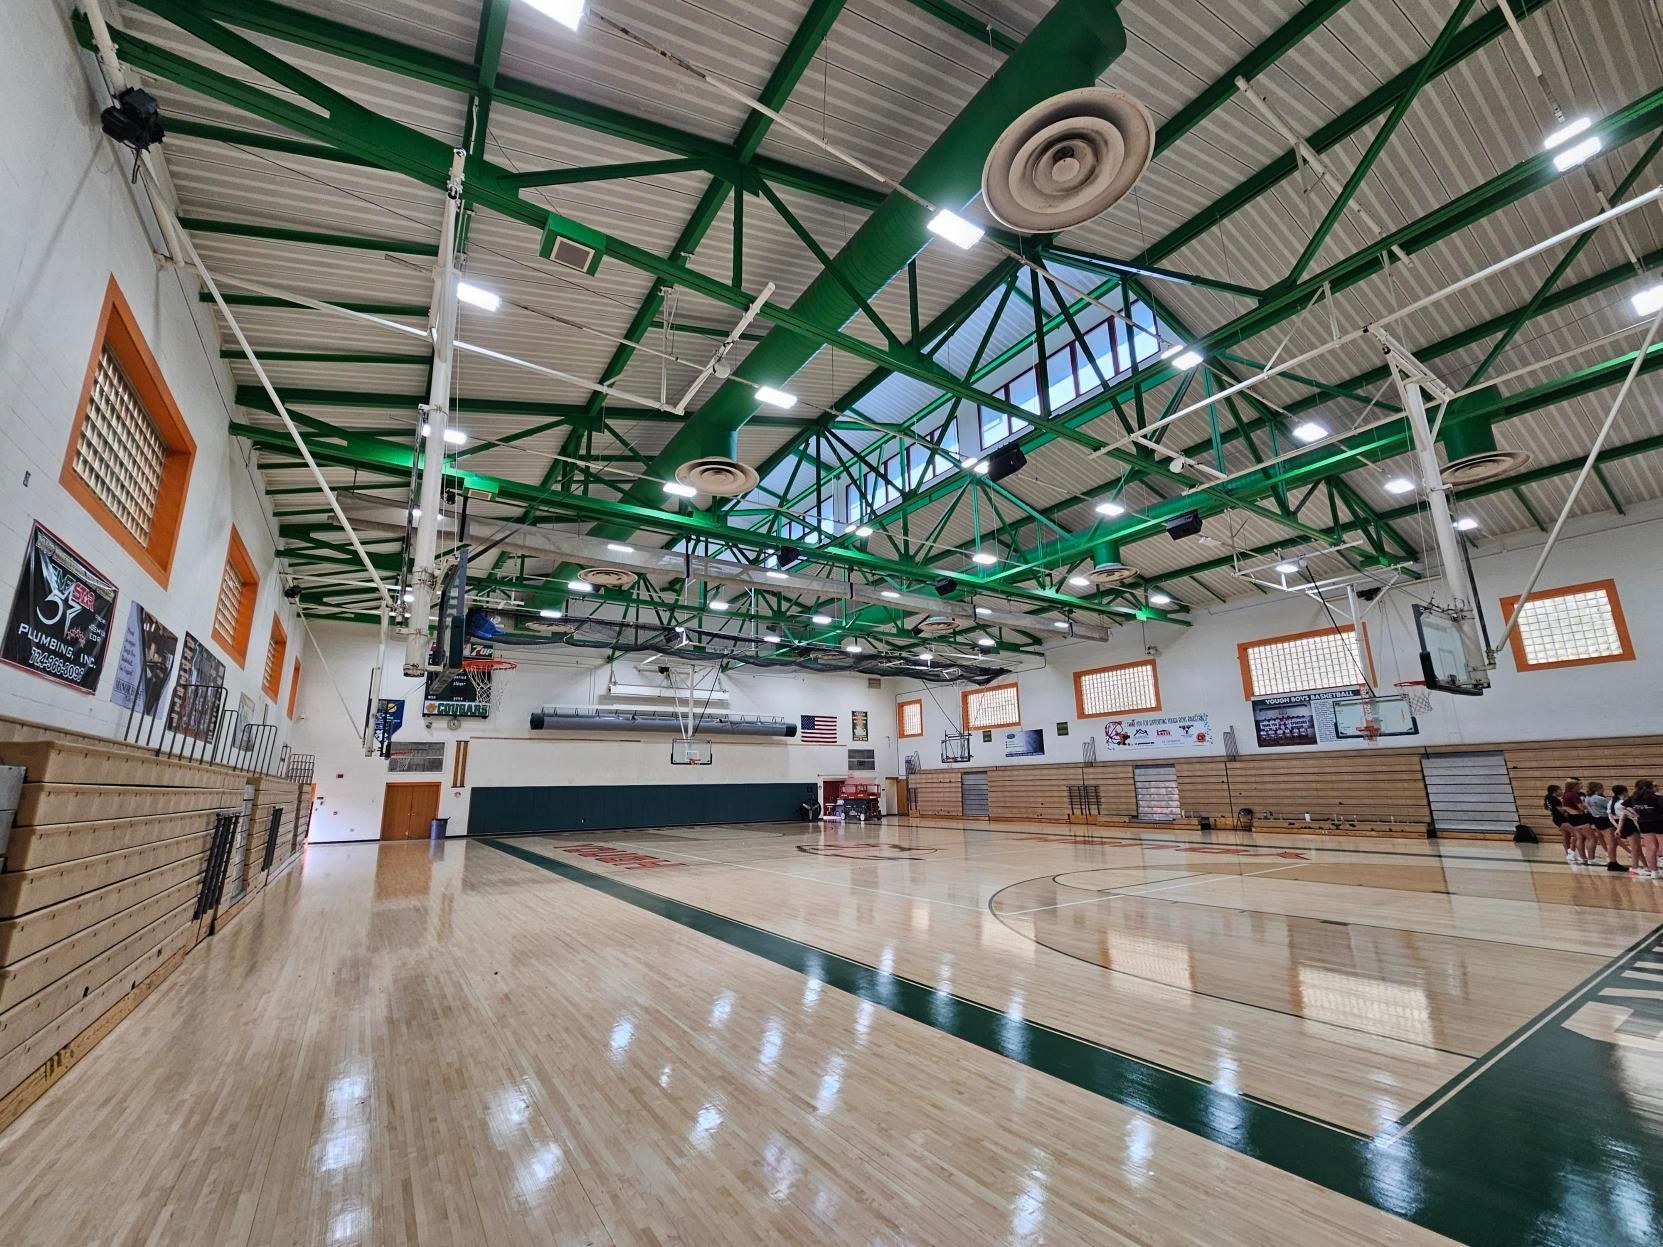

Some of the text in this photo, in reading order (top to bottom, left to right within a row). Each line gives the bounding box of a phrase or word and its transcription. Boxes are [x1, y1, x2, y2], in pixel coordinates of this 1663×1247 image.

[18, 623, 74, 660] PLUMBING,
[80, 653, 97, 669] INC.
[471, 645, 493, 656] 7UP
[1265, 691, 1353, 705] YOUGH BOYS BASKETBALL
[437, 702, 488, 716] COUGARS
